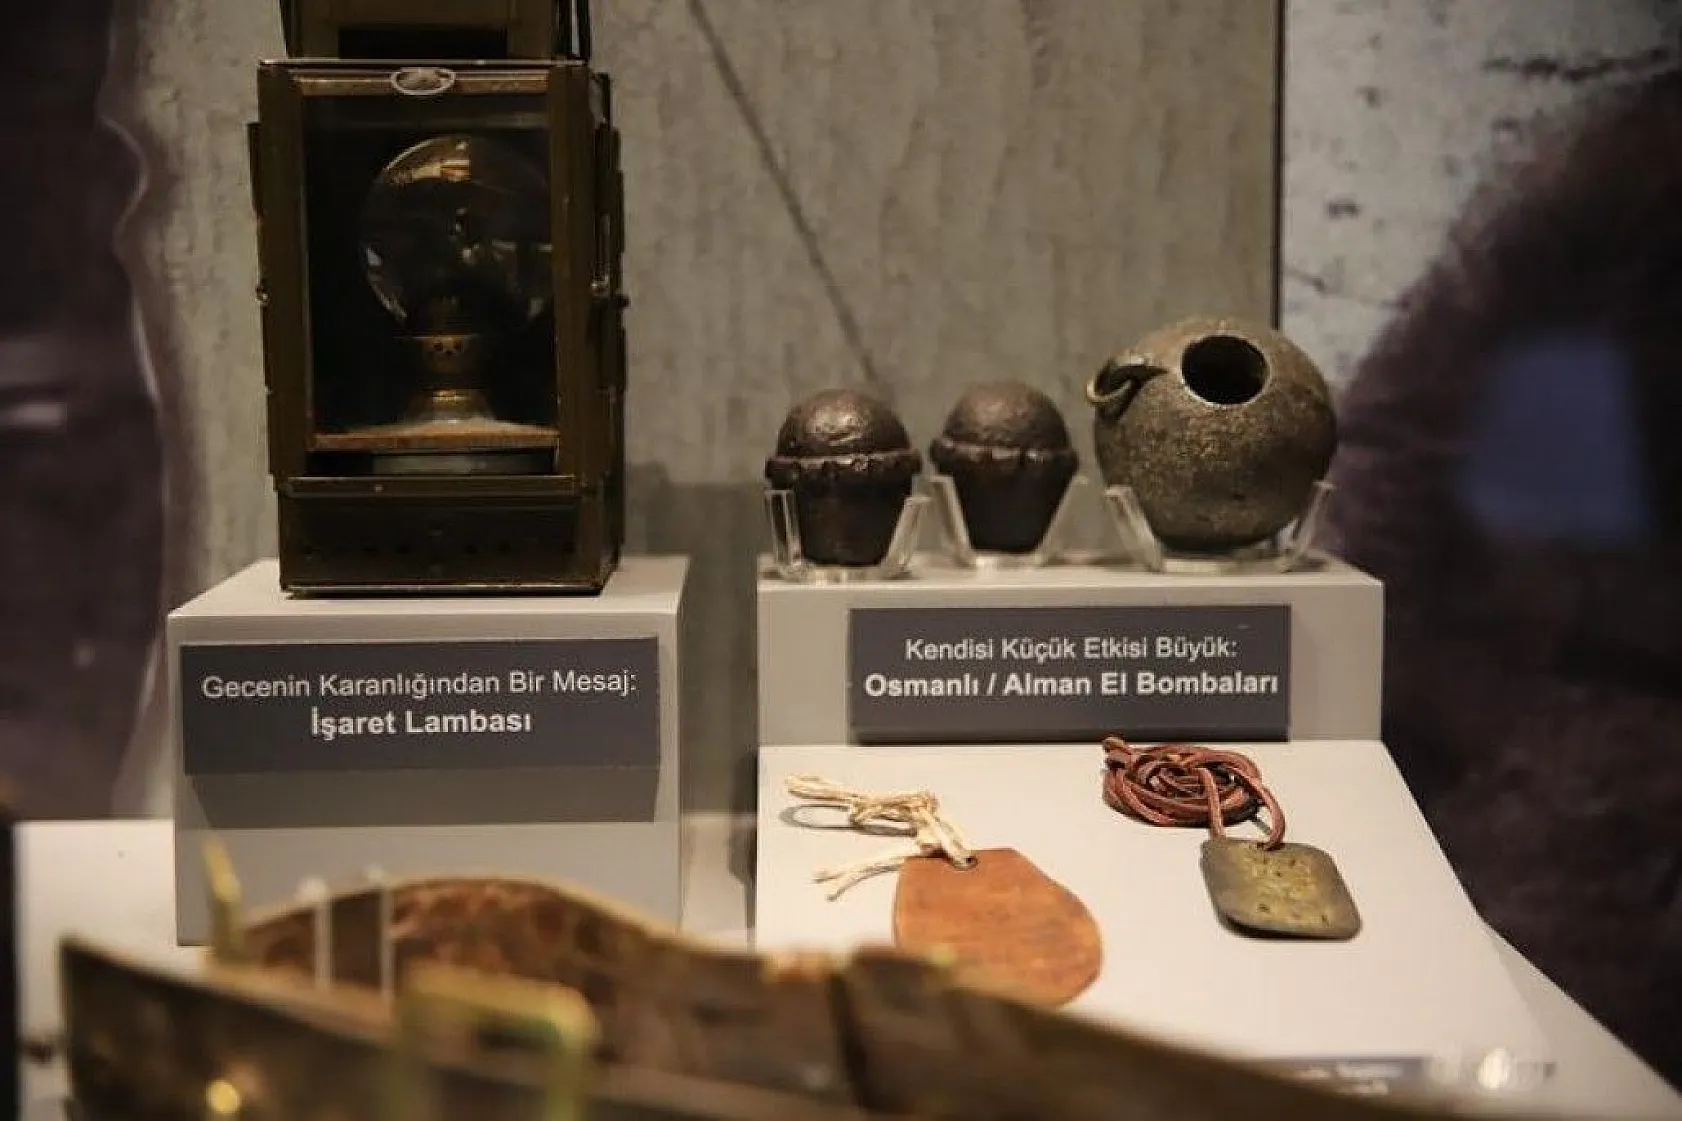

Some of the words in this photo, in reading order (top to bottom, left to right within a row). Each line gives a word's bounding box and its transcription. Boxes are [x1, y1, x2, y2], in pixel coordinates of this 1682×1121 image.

[905, 638, 994, 661] Kendisi
[1001, 637, 1077, 664] Küçük
[1083, 636, 1147, 659] Etkisi
[1155, 636, 1237, 663] Büyük:
[202, 676, 310, 698] Gecenin
[319, 672, 500, 700] Karanlığından
[509, 669, 545, 694] Bir
[552, 669, 638, 697] Mesaj:
[864, 673, 980, 697] Osmanlı
[986, 672, 998, 697] /
[1001, 673, 1093, 697] Alman
[1101, 671, 1127, 696] El
[1136, 671, 1278, 695] Bombaları
[311, 707, 397, 741] İşaret
[404, 708, 532, 734] Lambası
